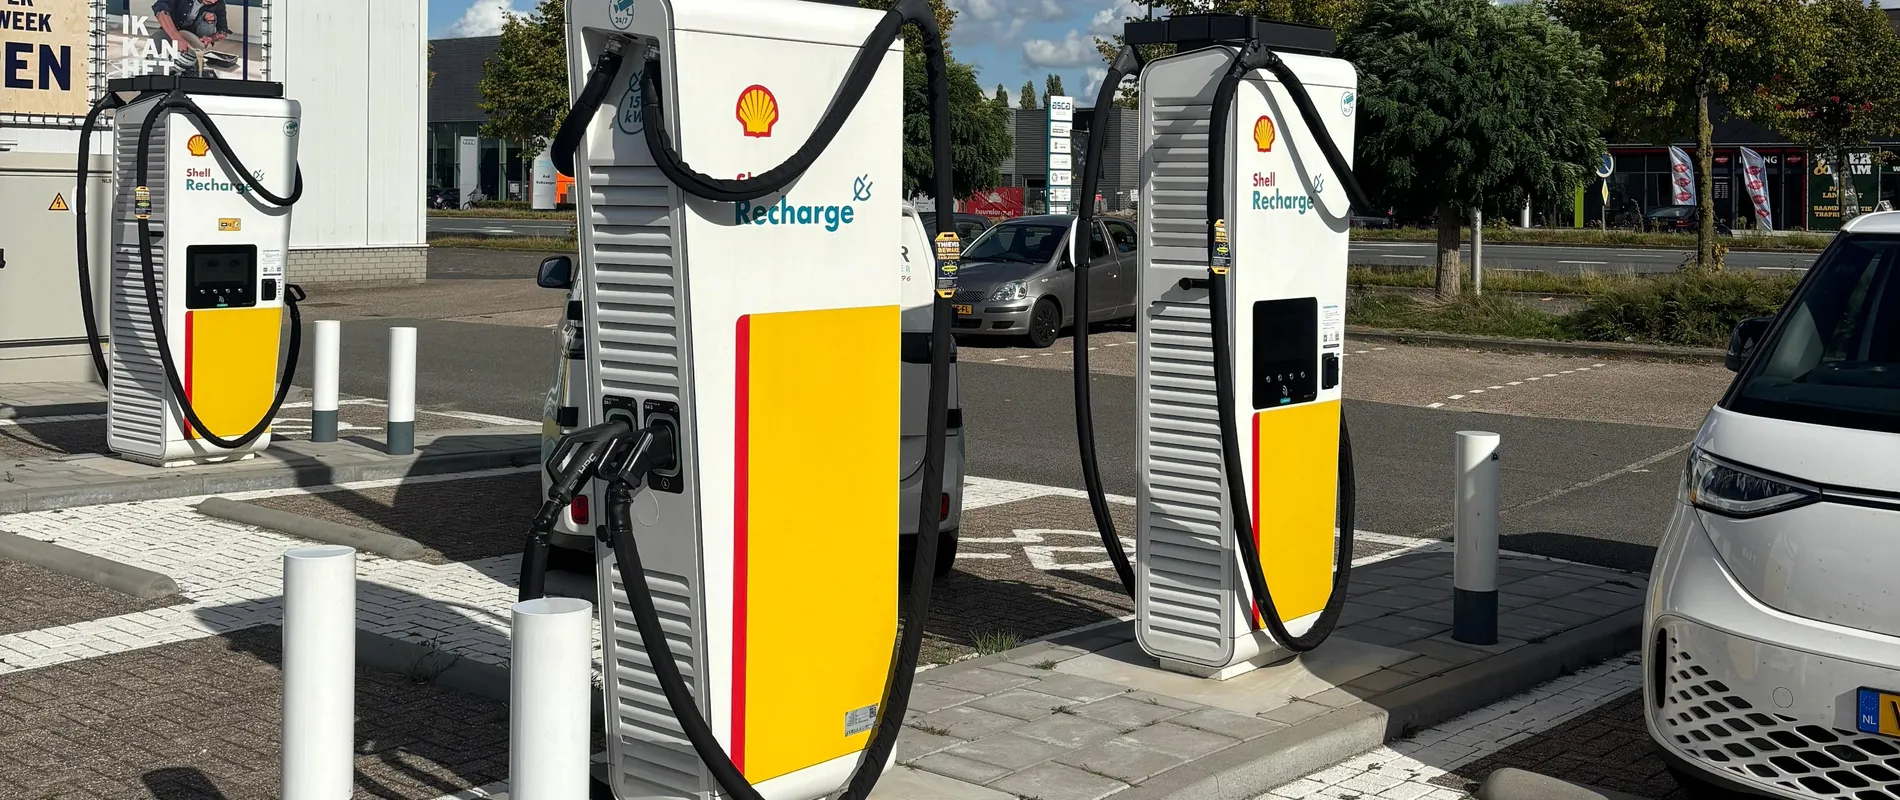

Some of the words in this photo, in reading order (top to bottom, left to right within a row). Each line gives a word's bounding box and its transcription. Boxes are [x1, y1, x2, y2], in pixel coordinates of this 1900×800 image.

[0, 10, 52, 32] WEEK
[122, 14, 149, 36] IK
[122, 36, 179, 60] KAN
[629, 96, 641, 109] 15
[186, 168, 211, 178] Shell
[1253, 171, 1276, 187] Shell
[186, 178, 253, 195] Recharge
[1252, 187, 1314, 215] Recharge
[735, 195, 855, 232] Recharge
[578, 453, 597, 474] HPC
[1862, 714, 1876, 725] NL
